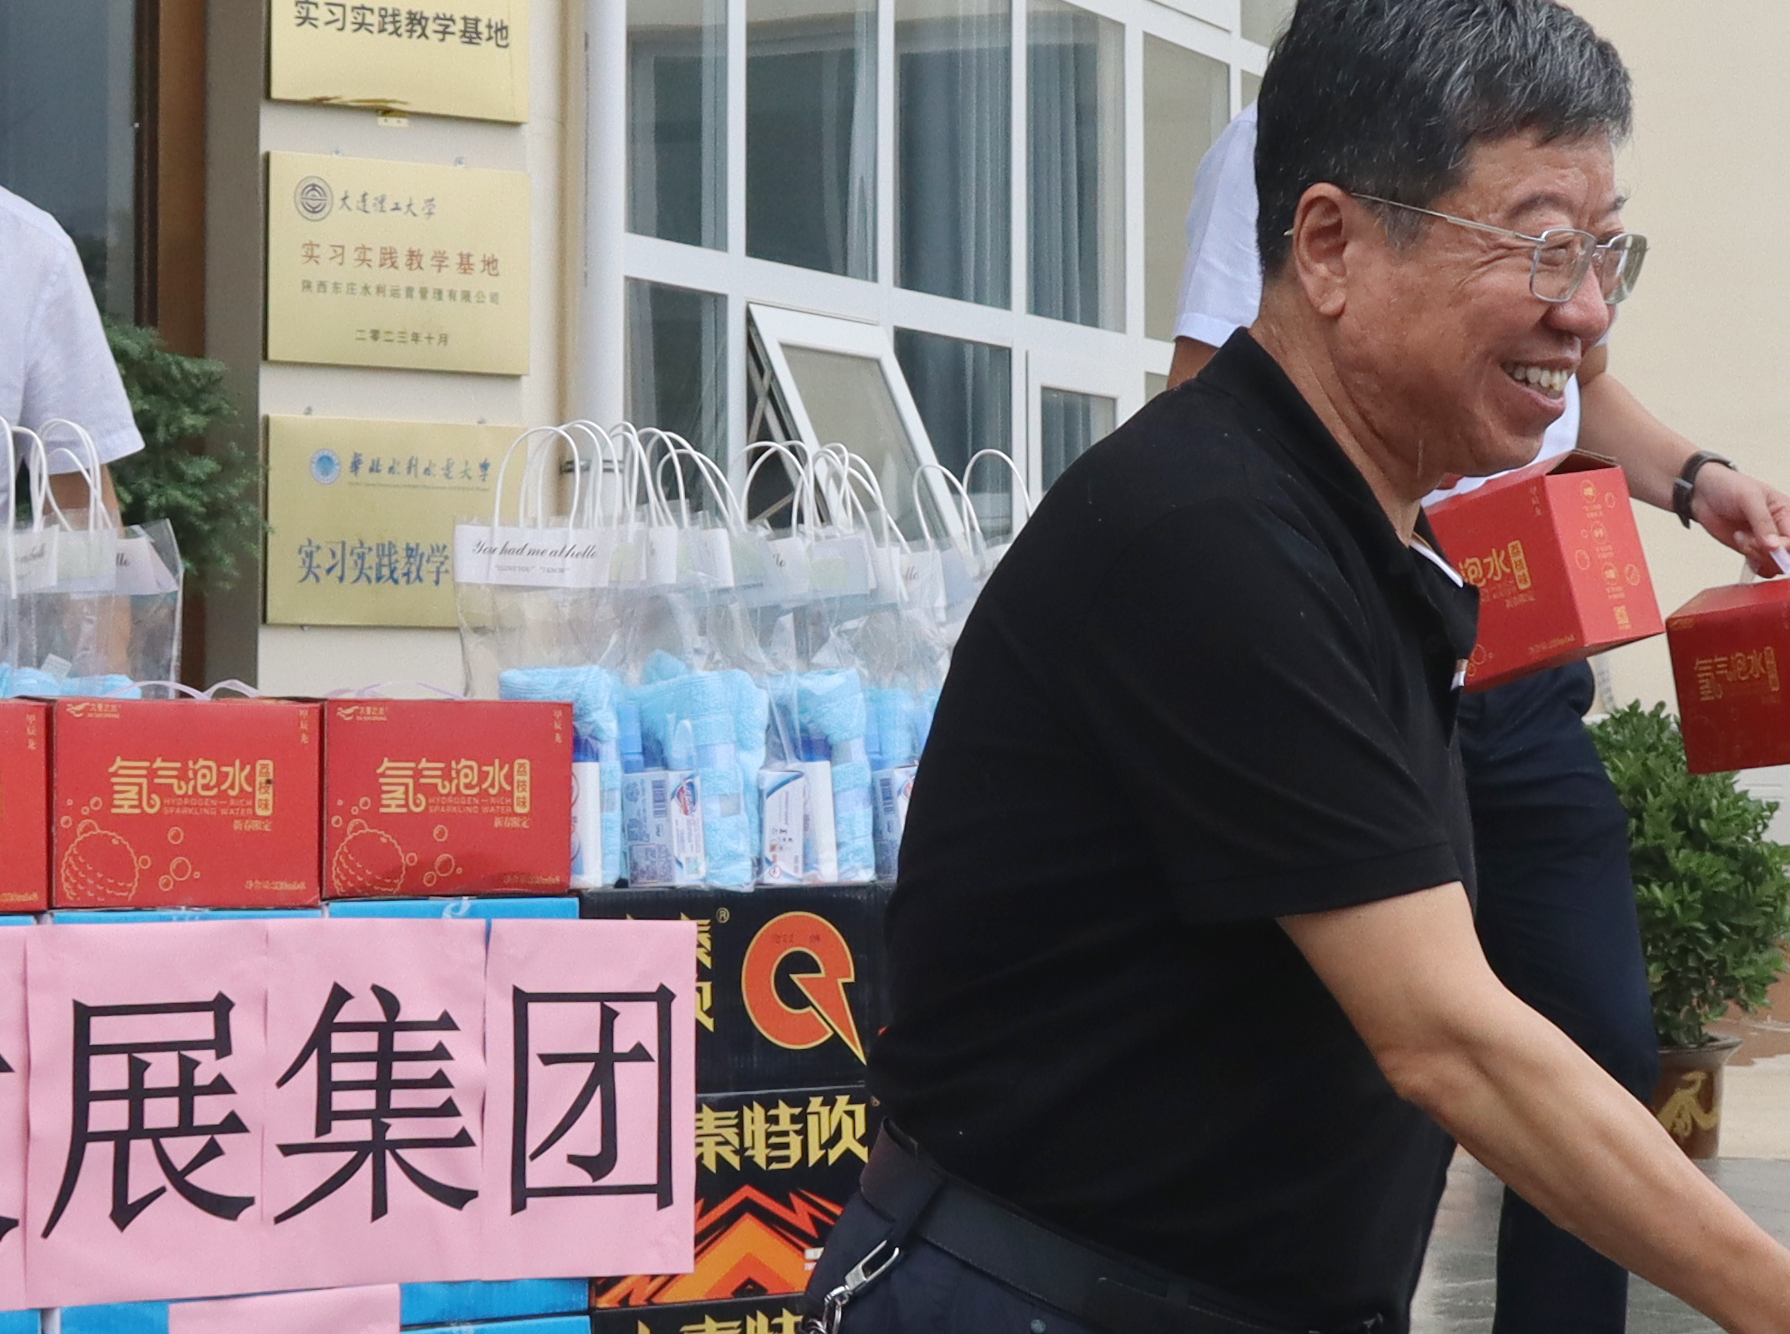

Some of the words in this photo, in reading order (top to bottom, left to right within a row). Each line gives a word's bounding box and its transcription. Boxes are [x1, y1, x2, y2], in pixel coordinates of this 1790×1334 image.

[340, 190, 438, 219] 大连理工大学
[301, 240, 501, 278] 实习实践教学基地
[301, 278, 501, 305] 陕西东庄水利运营管理有限公司
[355, 328, 450, 347] 二零二三年十月
[297, 537, 451, 587] 实习实践教学
[498, 541, 529, 556] had
[108, 756, 253, 814] 氢气泡水
[376, 757, 512, 813] 氢气泡水
